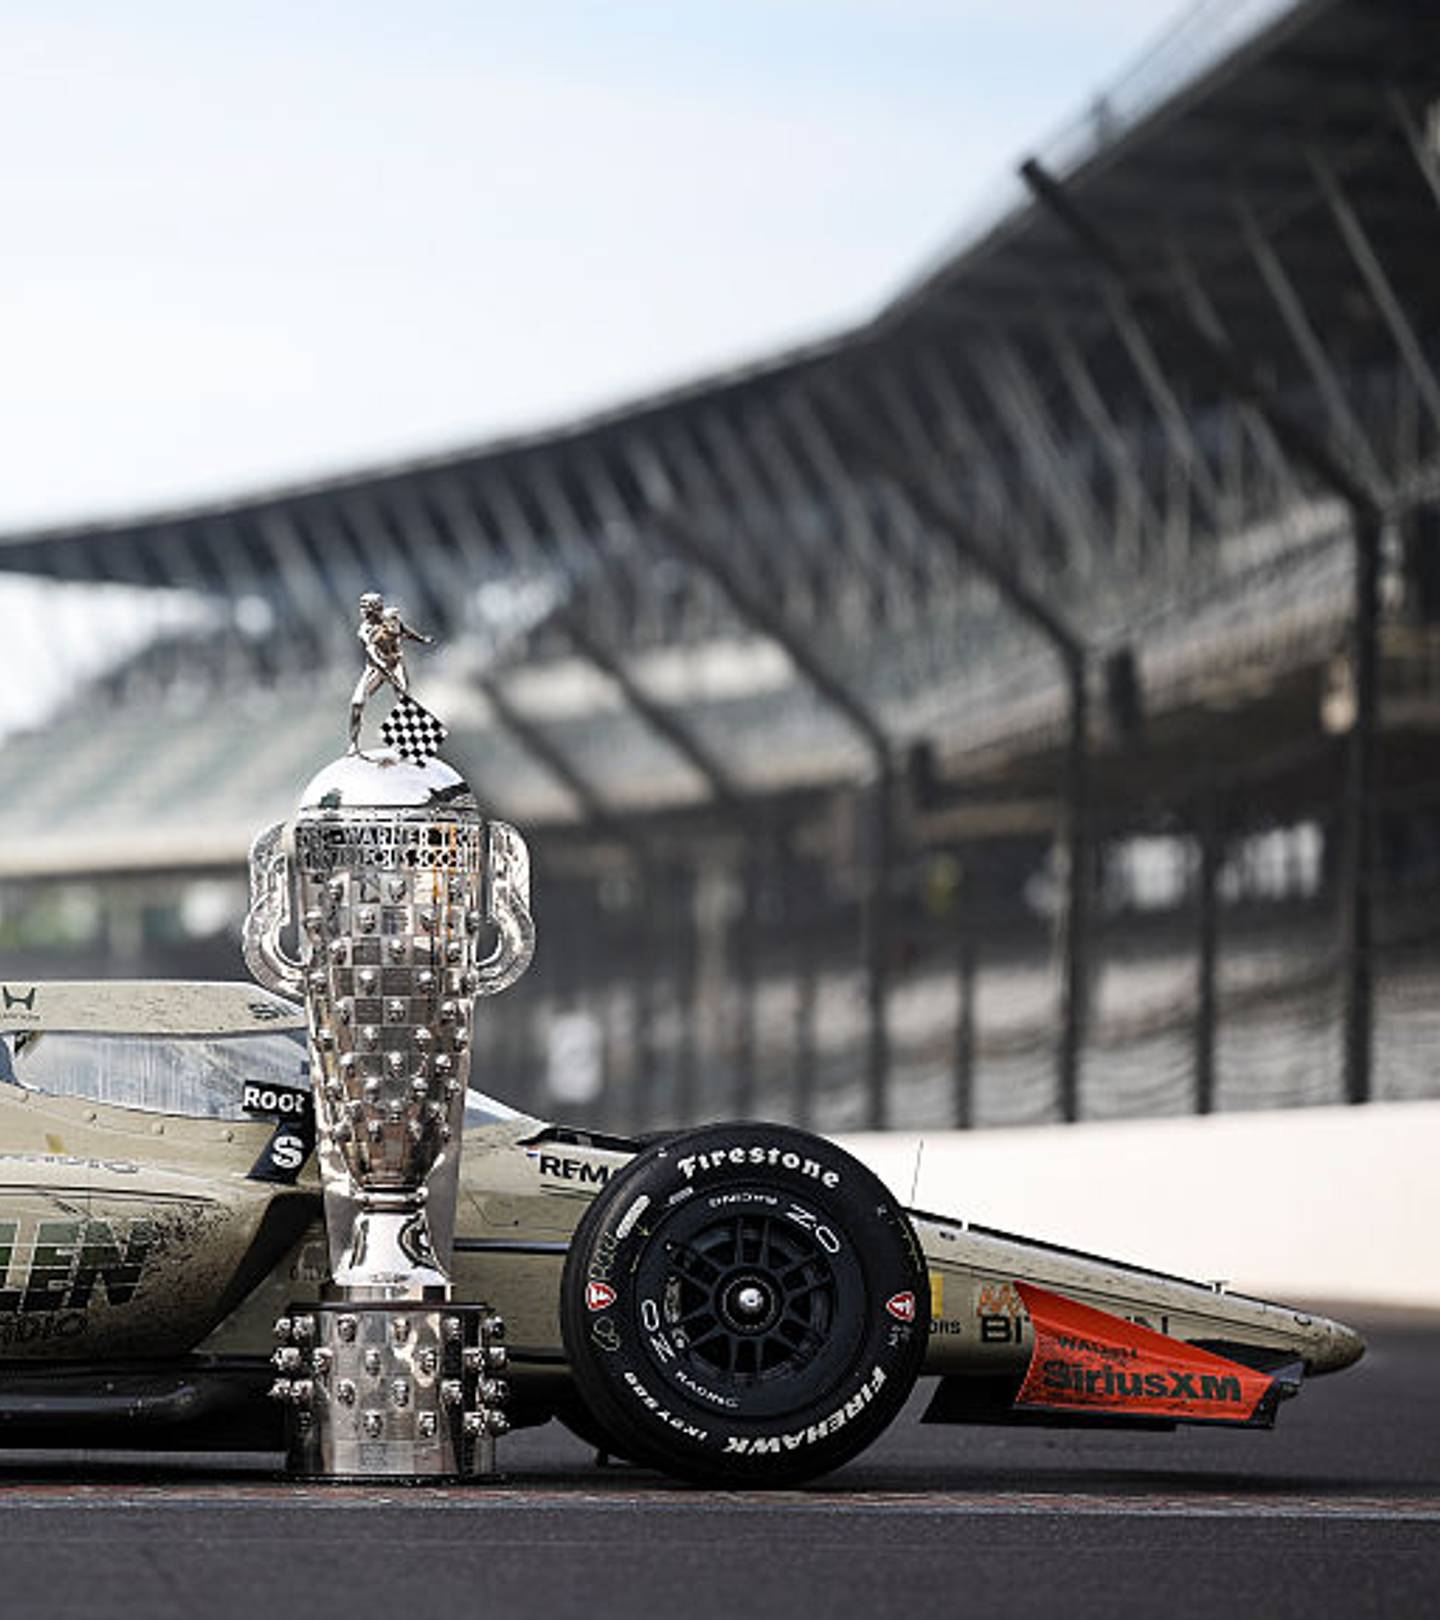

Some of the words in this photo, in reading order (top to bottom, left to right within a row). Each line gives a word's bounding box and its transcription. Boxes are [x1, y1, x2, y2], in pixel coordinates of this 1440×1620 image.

[243, 1086, 305, 1113] Root
[677, 1146, 841, 1189] Firestone
[1043, 1360, 1243, 1403] SiriusXM
[722, 1365, 888, 1455] FIREHAWK
